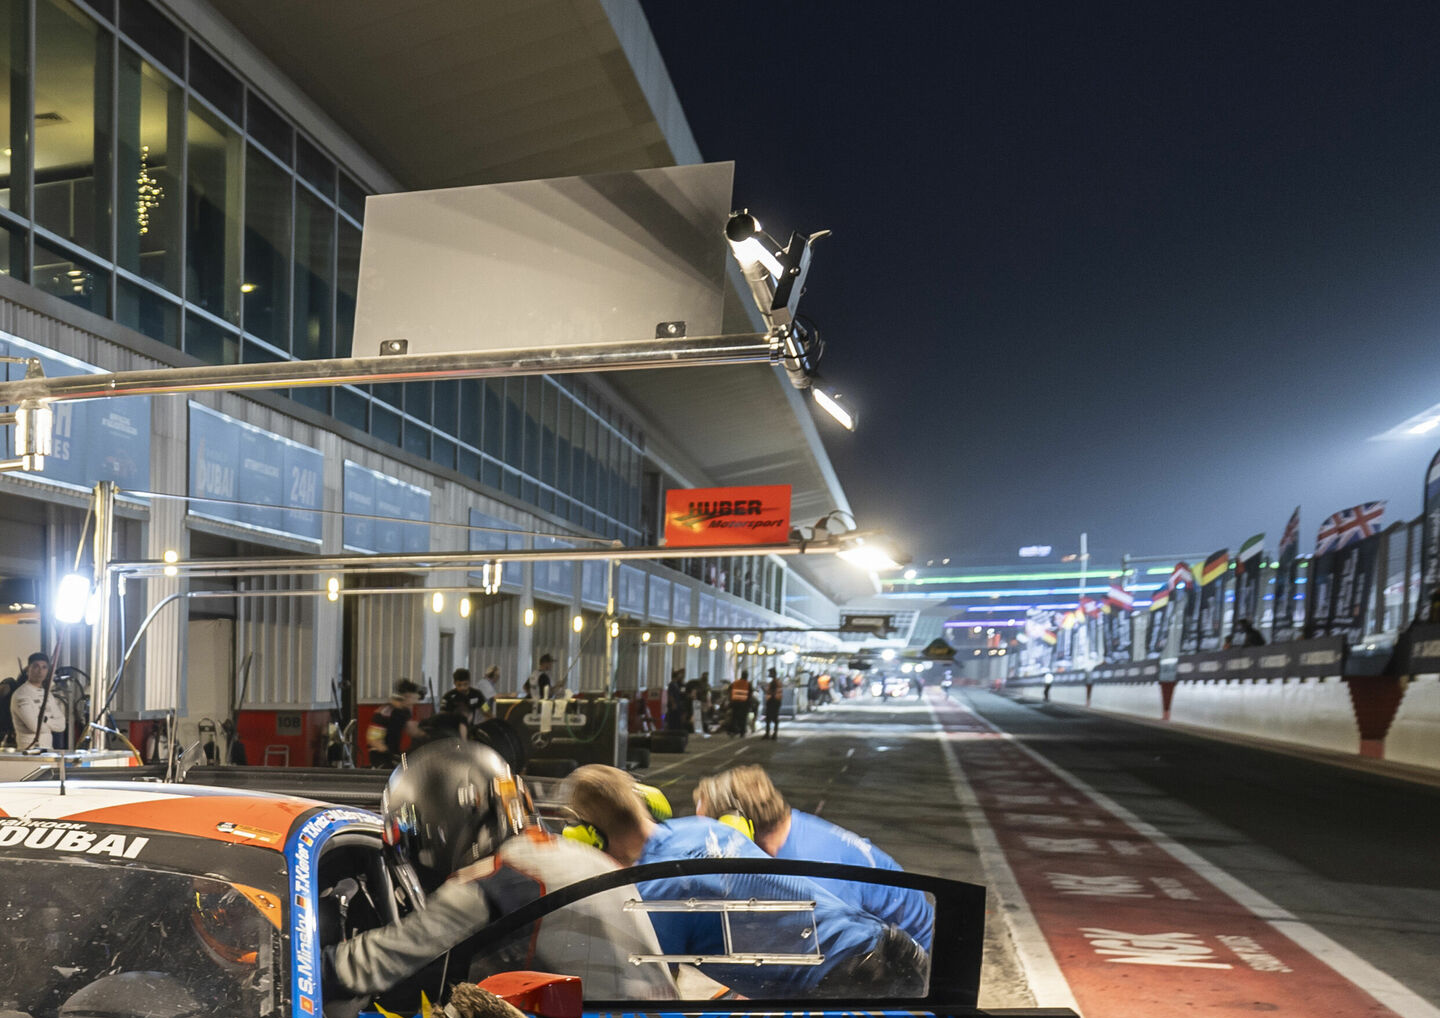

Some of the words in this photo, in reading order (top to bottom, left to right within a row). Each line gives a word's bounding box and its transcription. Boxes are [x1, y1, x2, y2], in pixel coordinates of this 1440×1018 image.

[688, 500, 762, 516] HUBER
[708, 518, 784, 530] Motorsport
[1077, 927, 1234, 970] NGK
